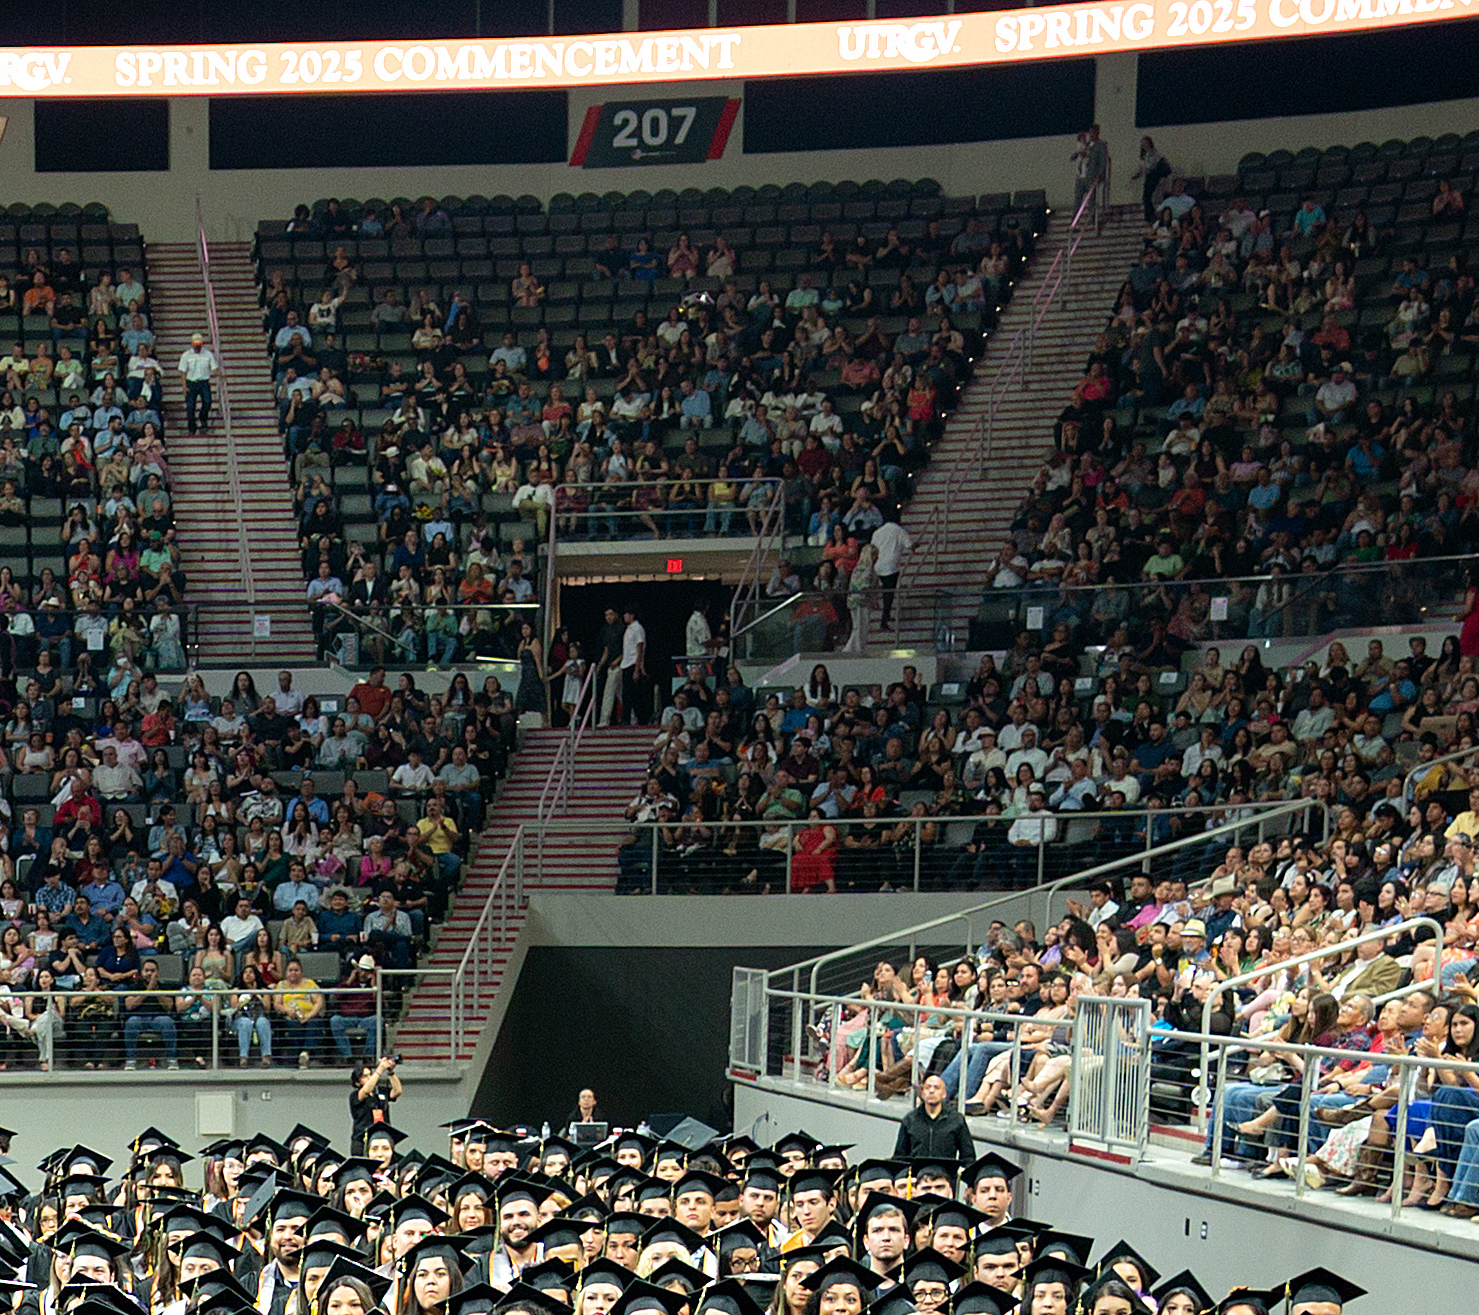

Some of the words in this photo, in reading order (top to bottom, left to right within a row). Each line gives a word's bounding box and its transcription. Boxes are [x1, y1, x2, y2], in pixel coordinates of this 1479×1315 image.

[994, 1, 1155, 53] SPRING
[1165, 0, 1257, 36] 2025
[114, 49, 268, 88] SPRING
[278, 48, 363, 85] 2025
[373, 33, 742, 82] COMMENCEMENT
[612, 107, 697, 148] 207
